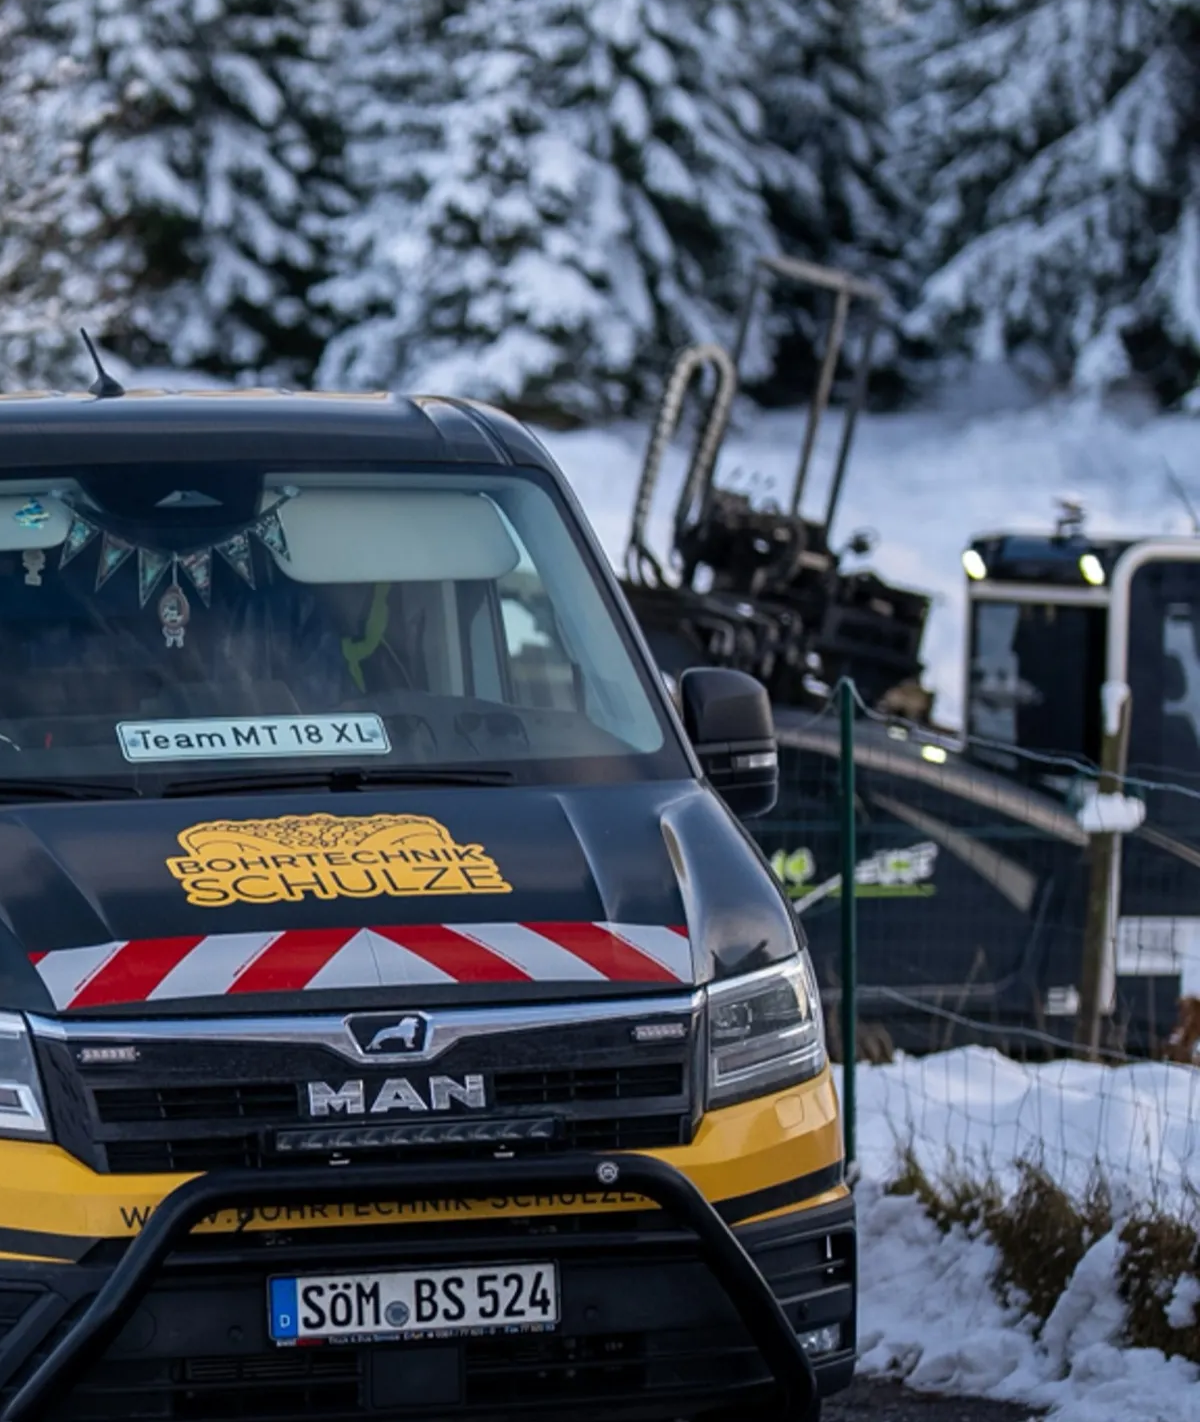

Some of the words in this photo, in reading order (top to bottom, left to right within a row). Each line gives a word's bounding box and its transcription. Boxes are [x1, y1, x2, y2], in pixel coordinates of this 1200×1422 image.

[135, 729, 227, 751] Team
[231, 725, 279, 747] MT
[291, 723, 324, 745] 18
[330, 721, 374, 744] XL
[175, 847, 486, 876] BOHRTECHNIK
[190, 865, 505, 903] SCHULZE
[308, 1074, 486, 1116] MAN
[301, 1280, 381, 1330] SÖM
[414, 1276, 466, 1323] BS
[477, 1270, 551, 1319] 524
[279, 1313, 291, 1329] D
